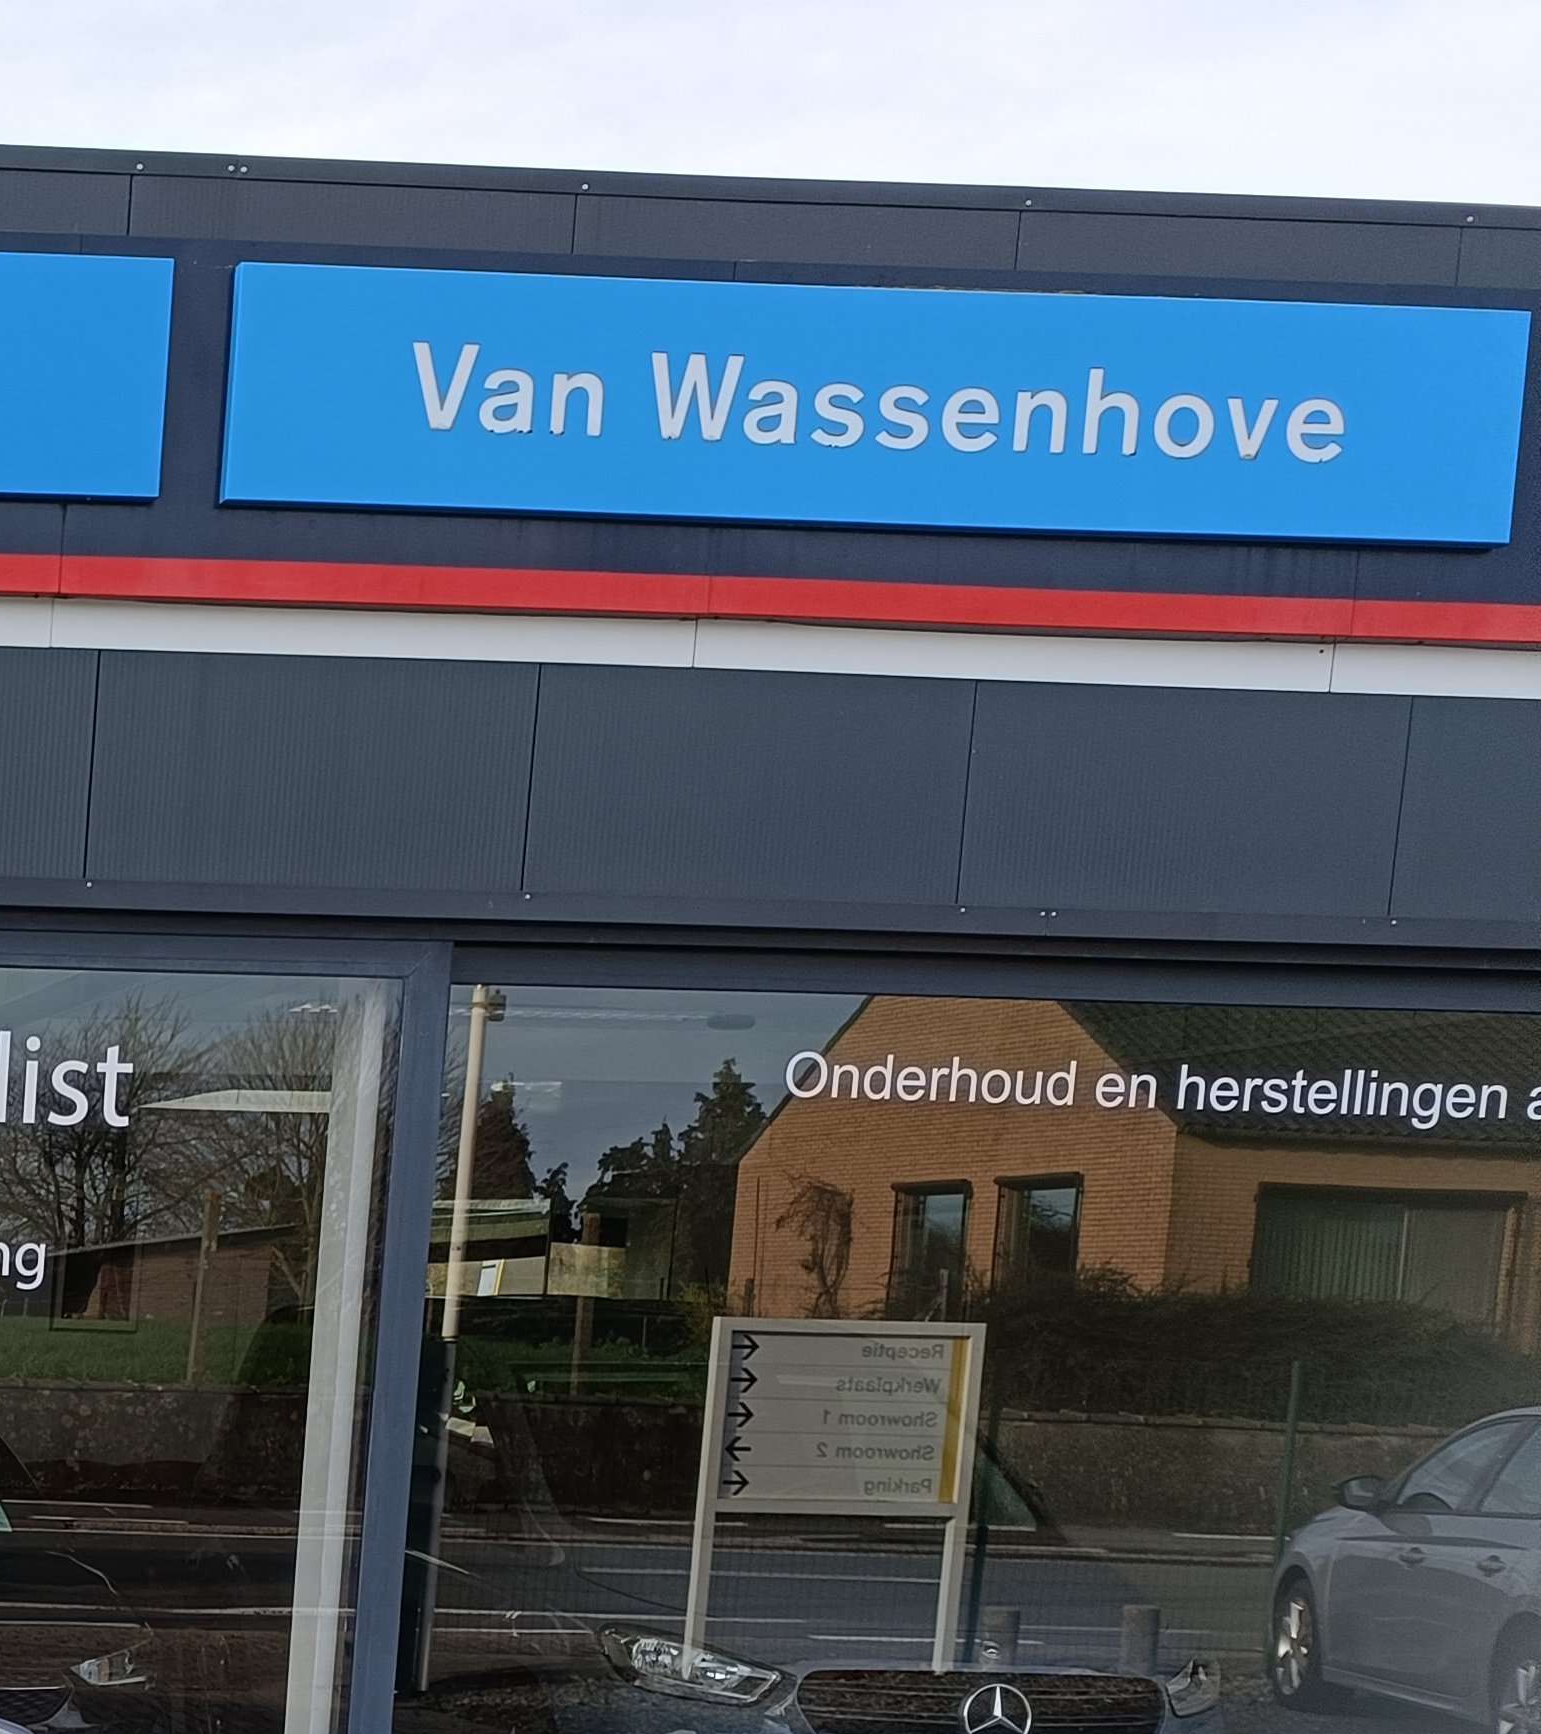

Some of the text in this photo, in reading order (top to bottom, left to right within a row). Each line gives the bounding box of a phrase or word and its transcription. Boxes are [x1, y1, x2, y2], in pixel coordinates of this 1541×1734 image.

[412, 341, 1346, 464] Van Wassenhove
[784, 1050, 1077, 1107] Onderhoud
[1095, 1072, 1158, 1109] en
[1176, 1064, 1507, 1130] herstellingen
